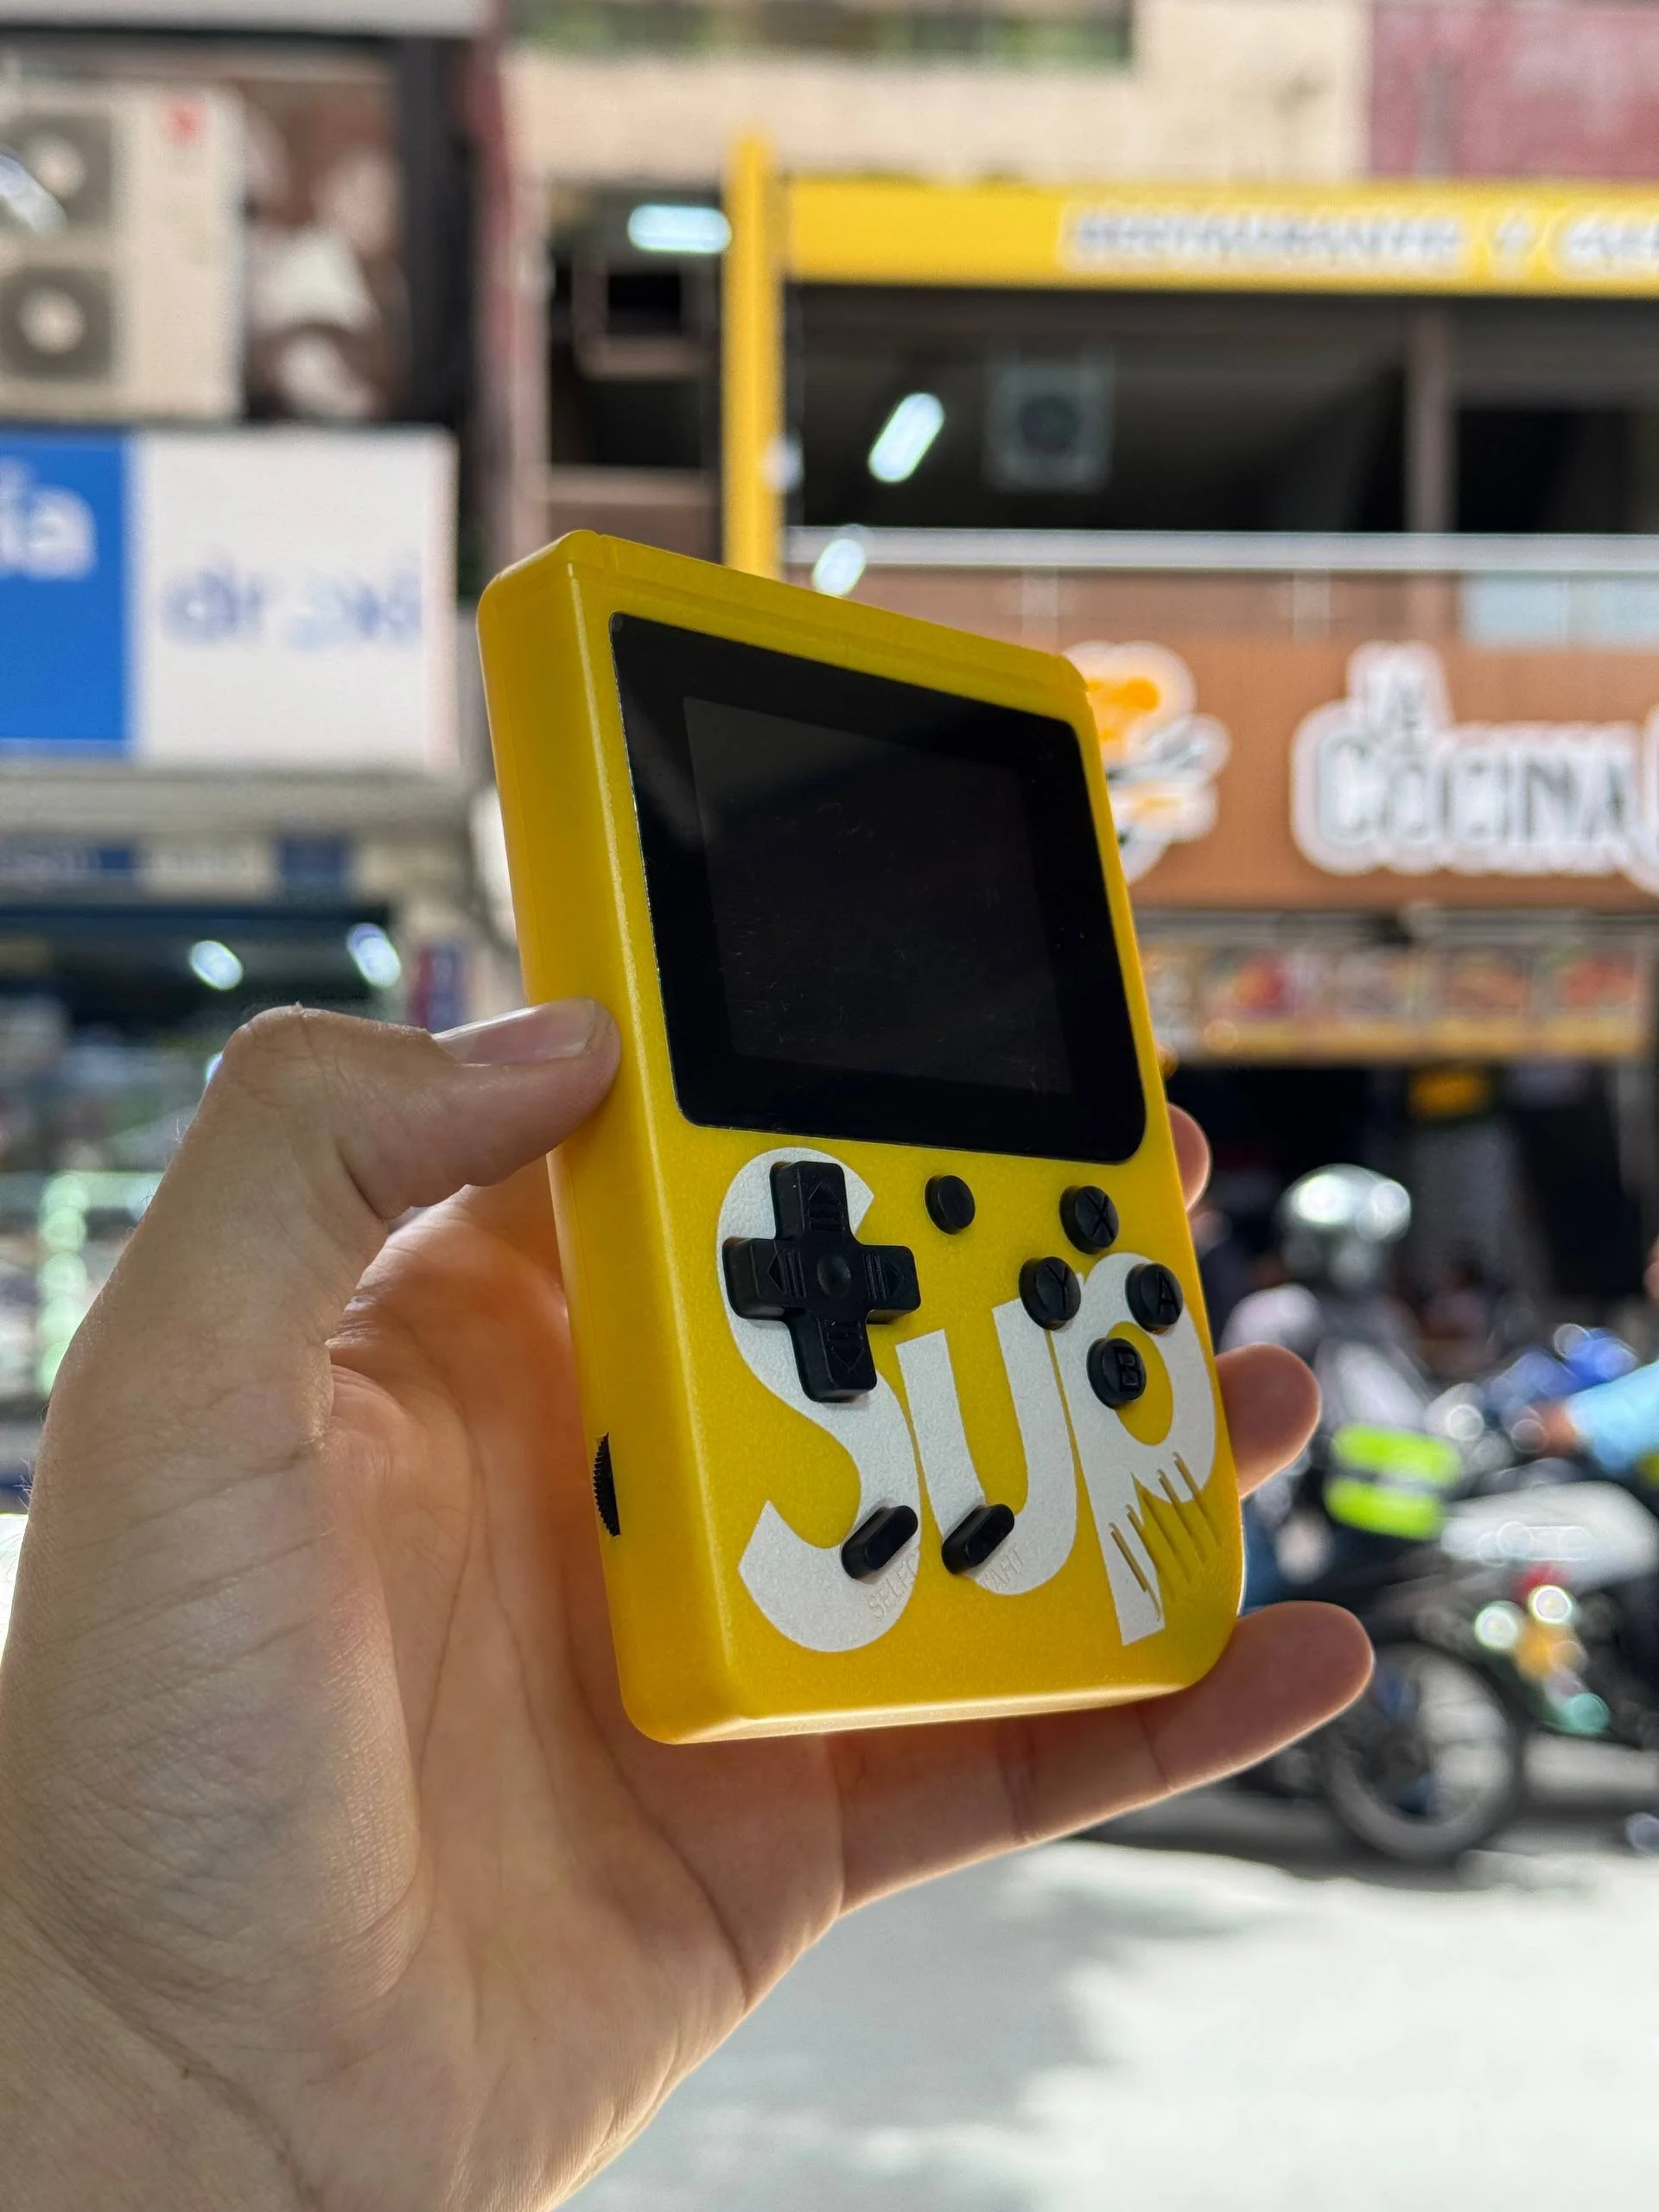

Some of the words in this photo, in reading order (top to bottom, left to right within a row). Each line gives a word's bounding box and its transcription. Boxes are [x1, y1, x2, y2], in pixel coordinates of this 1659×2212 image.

[1084, 1191, 1116, 1238] X
[1152, 1270, 1181, 1318] A
[1113, 1345, 1145, 1394] B
